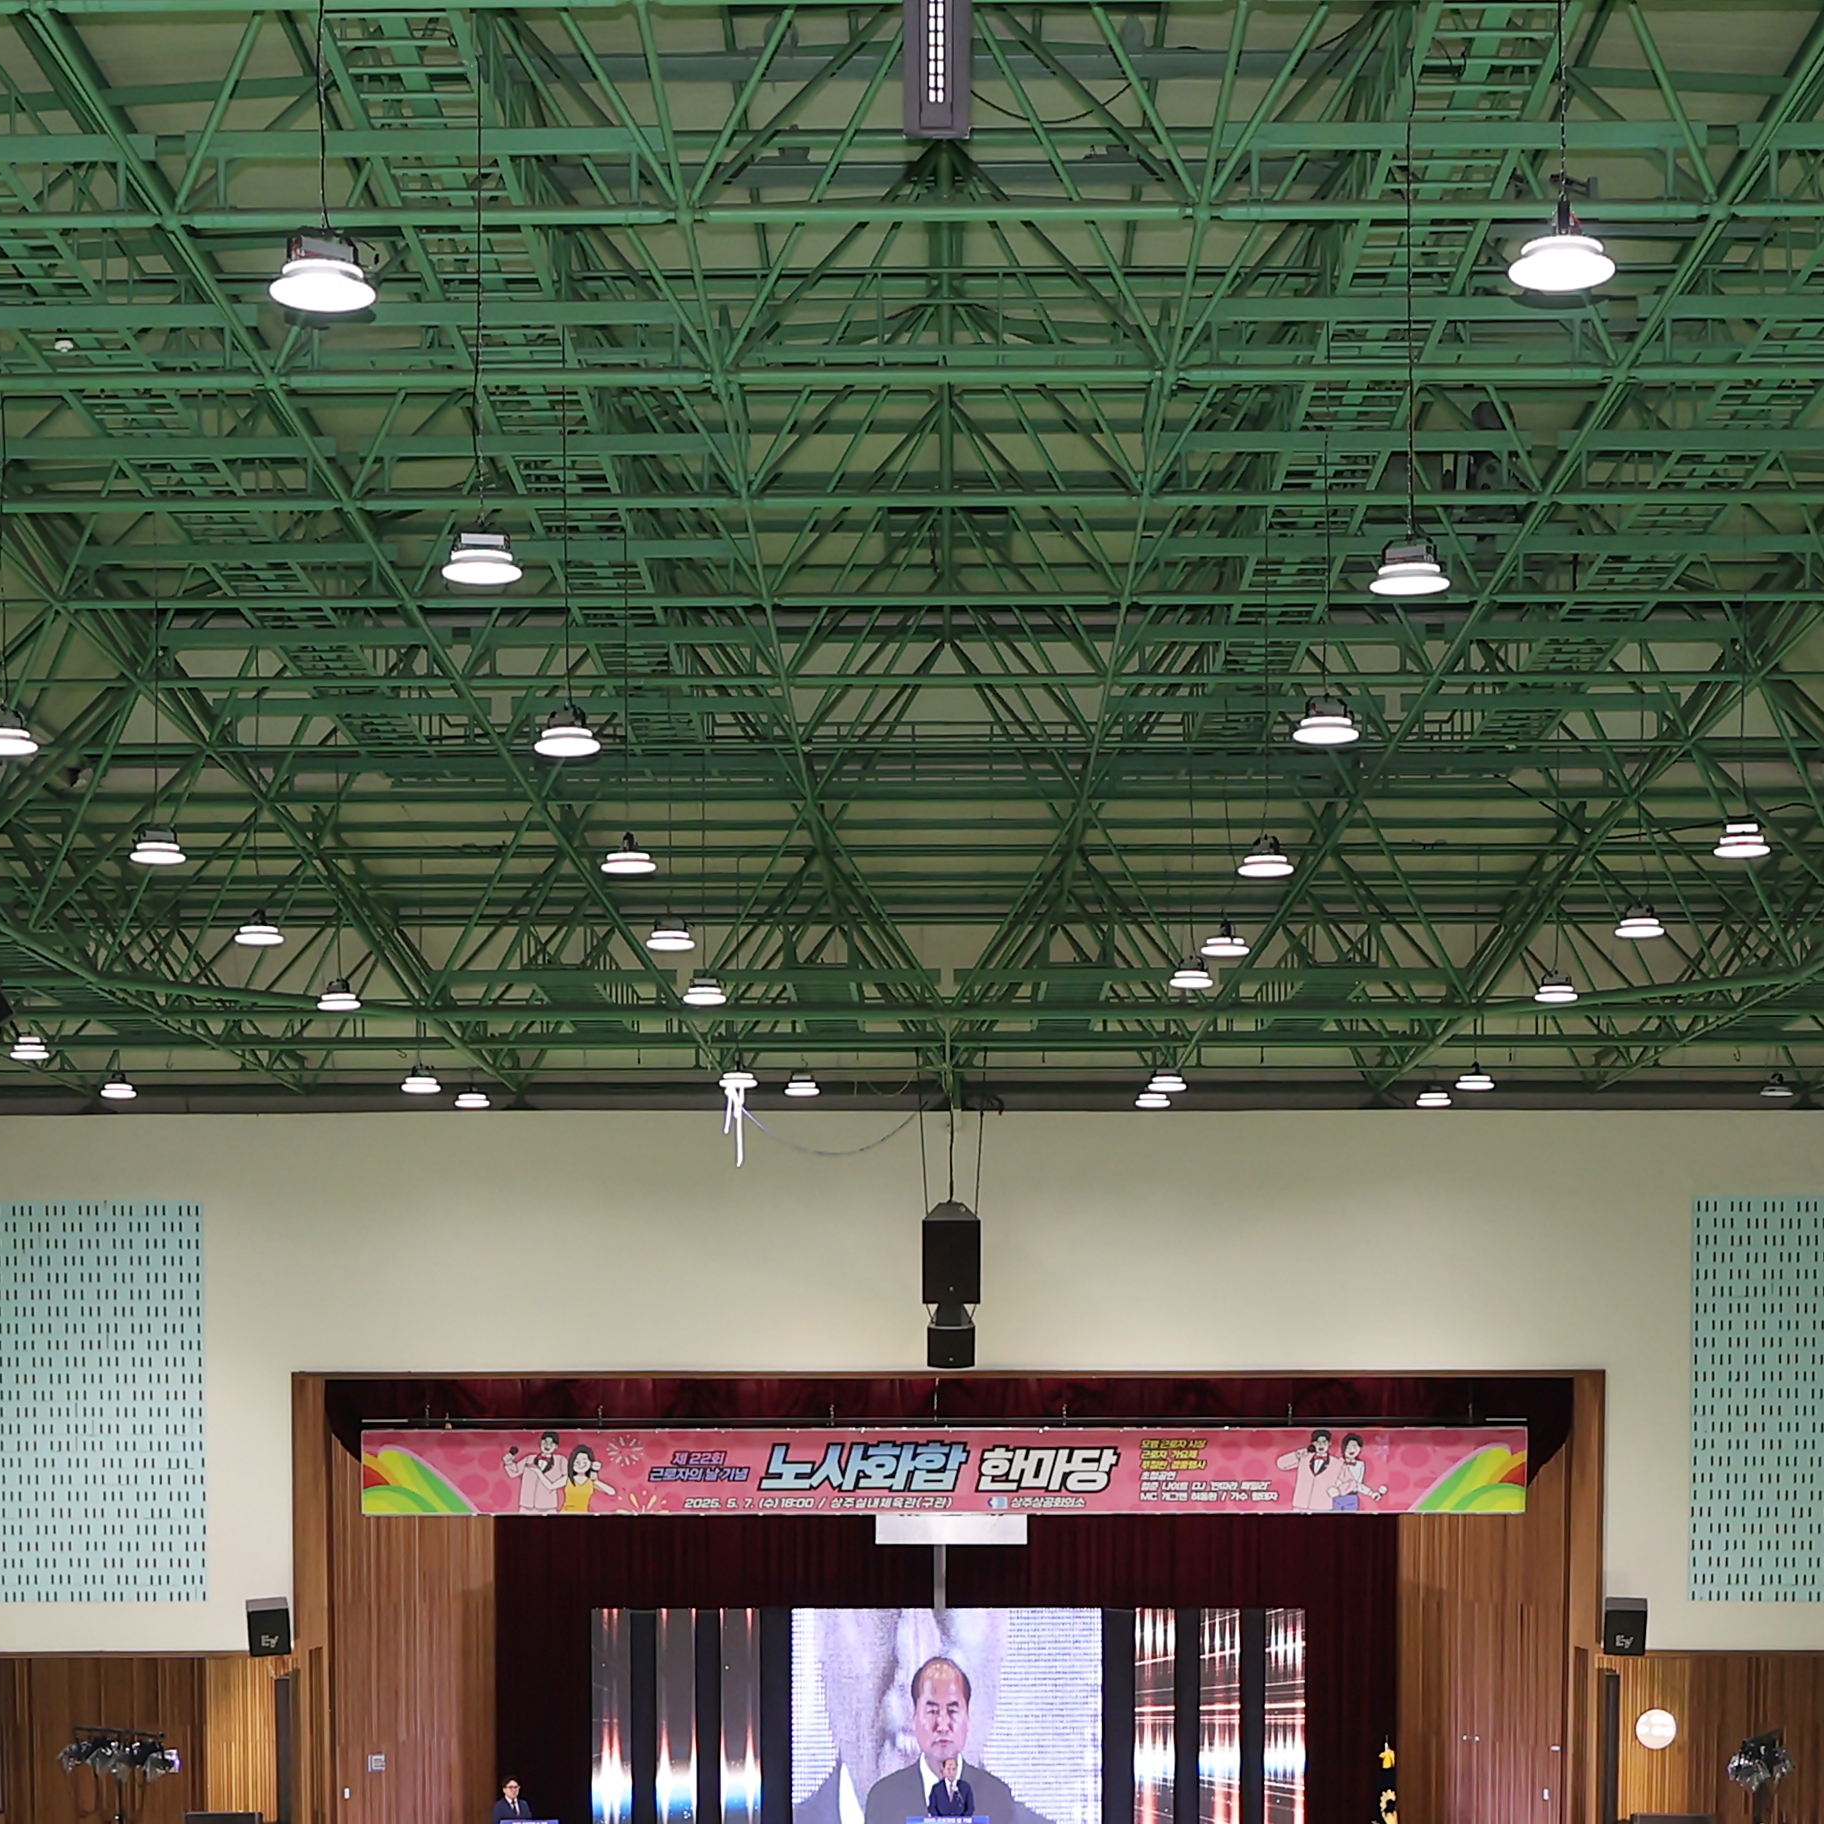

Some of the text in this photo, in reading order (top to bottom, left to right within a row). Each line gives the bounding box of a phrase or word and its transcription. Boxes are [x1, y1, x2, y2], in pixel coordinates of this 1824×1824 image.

[672, 1452, 725, 1465] 제 22회
[759, 1443, 968, 1490] 노사화합
[978, 1447, 1117, 1491] 한마당
[649, 1467, 749, 1481] 근로자의 날 기념
[1140, 1492, 1157, 1500] MC
[1230, 1491, 1249, 1501] 가수
[684, 1498, 721, 1509] 2025.
[726, 1498, 738, 1509] 5.
[743, 1498, 754, 1509] 7.
[1010, 1497, 1086, 1509] 상주상공회의소
